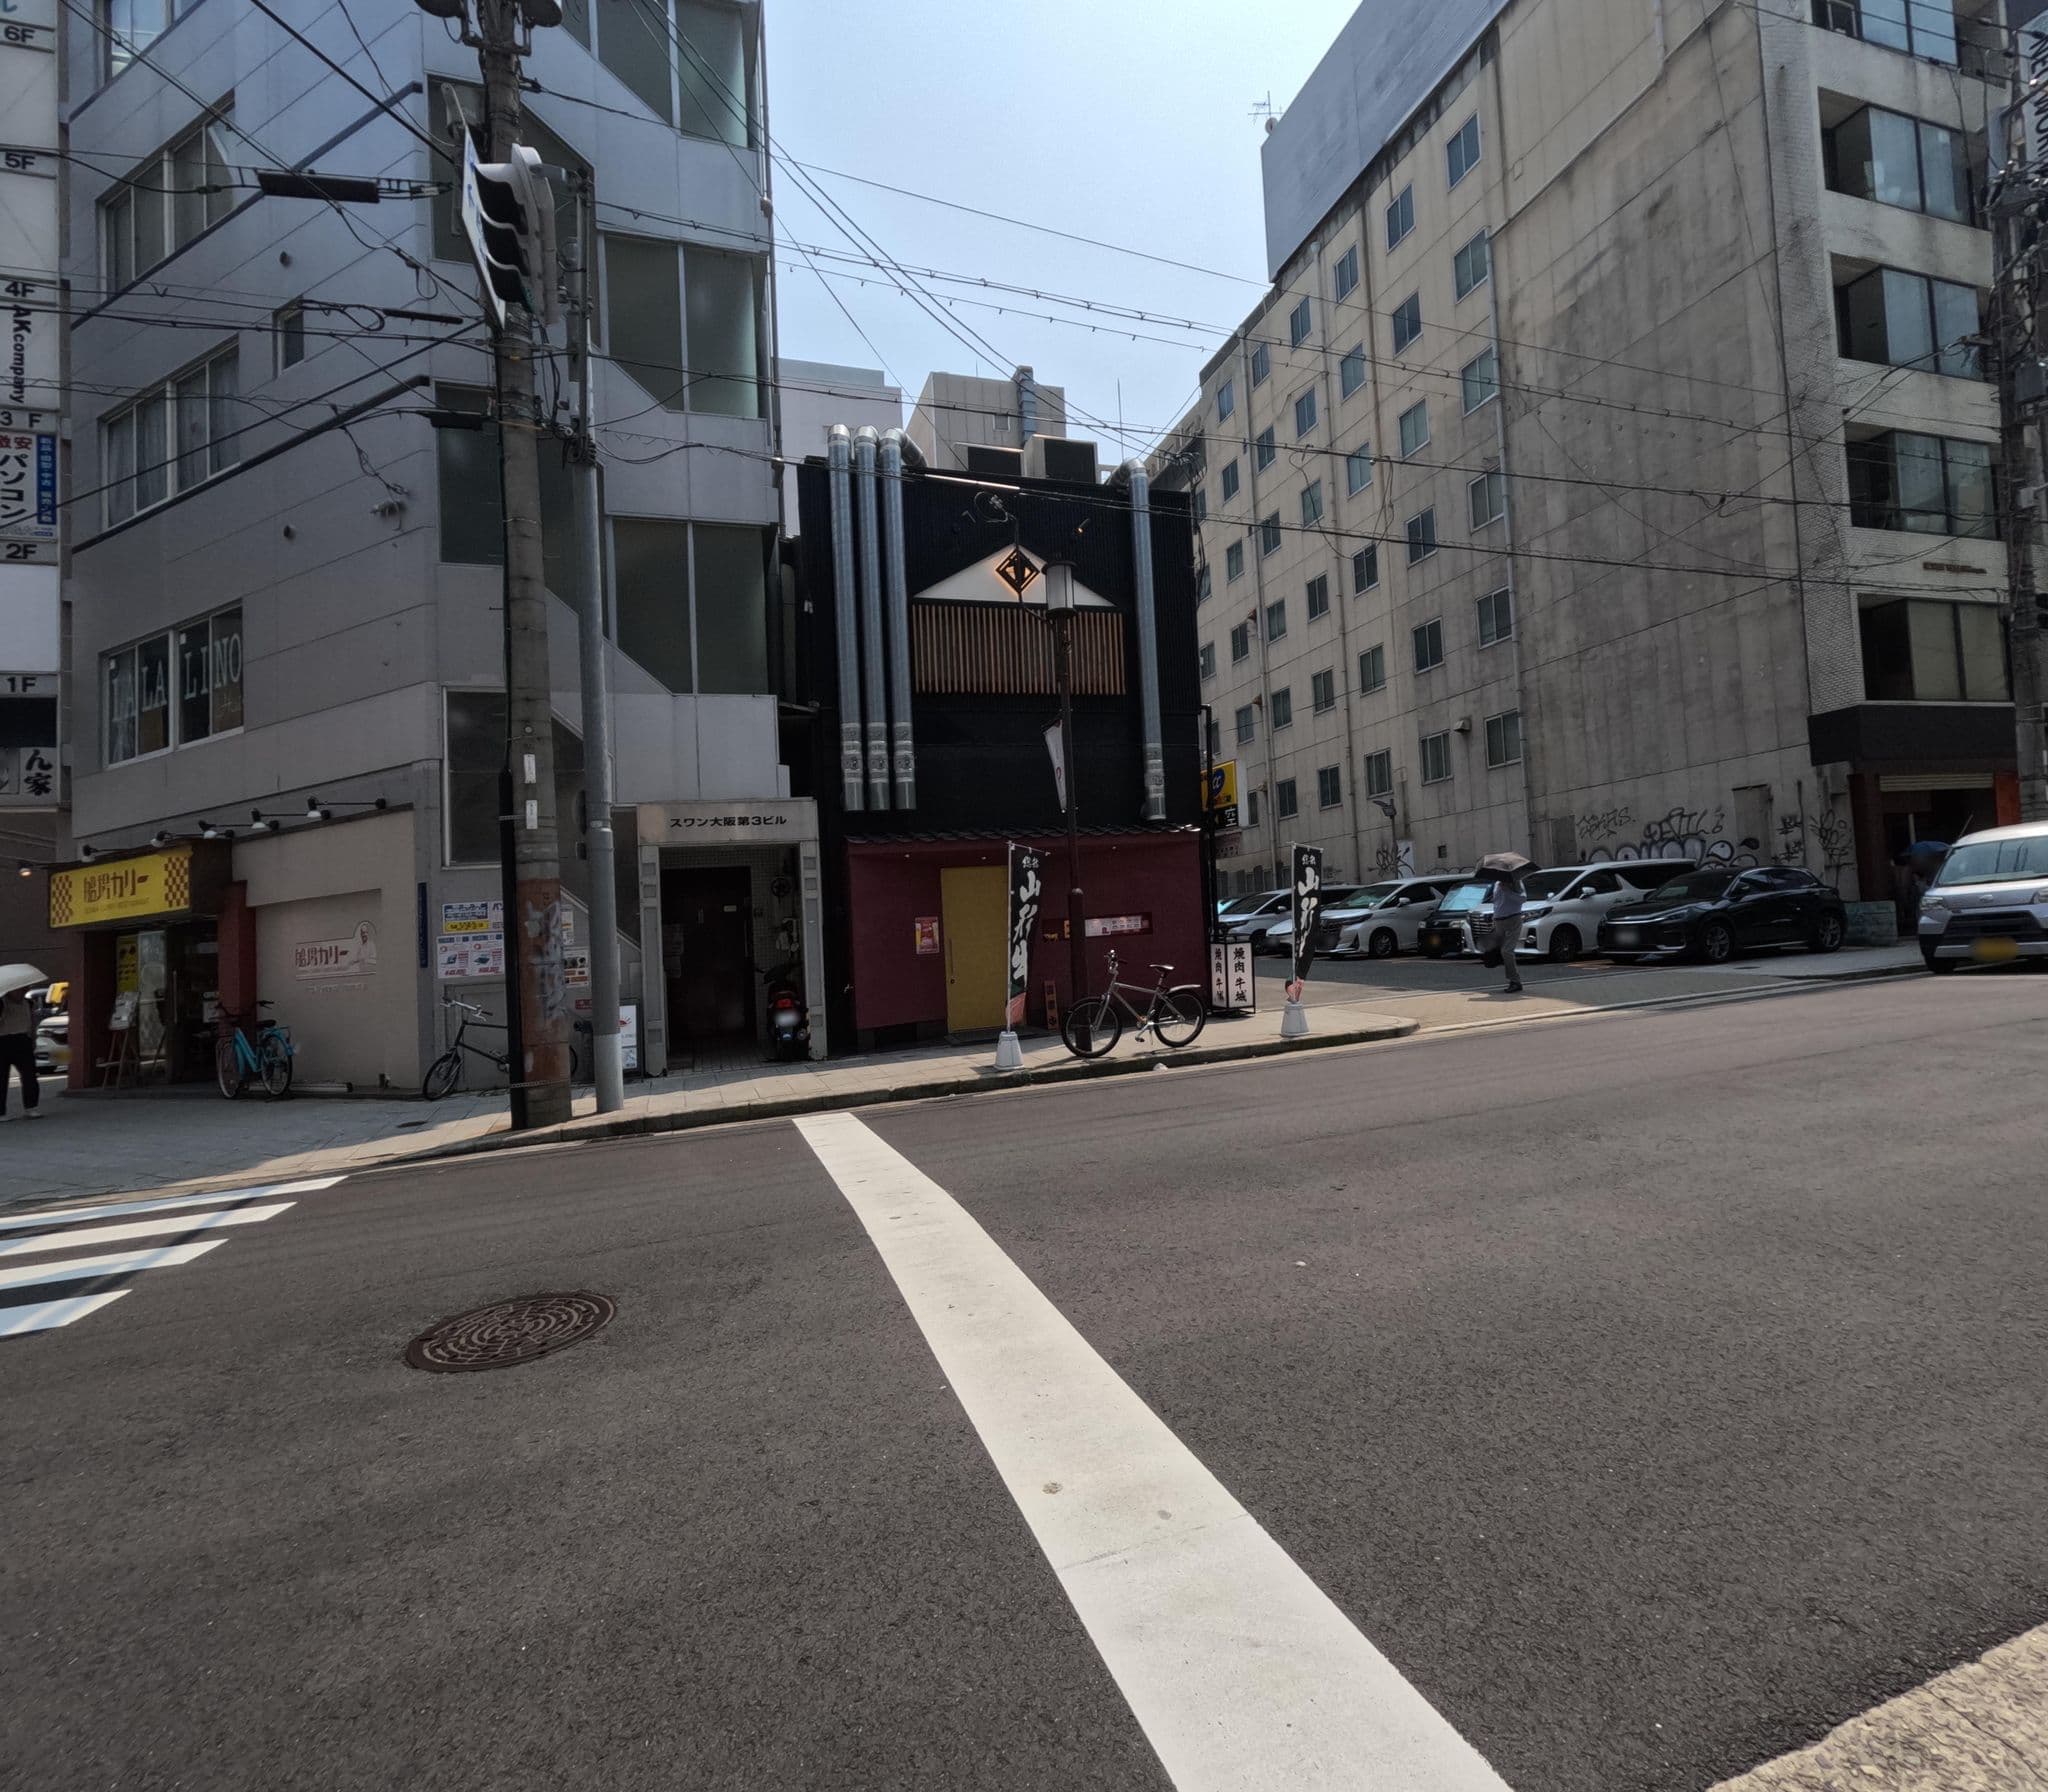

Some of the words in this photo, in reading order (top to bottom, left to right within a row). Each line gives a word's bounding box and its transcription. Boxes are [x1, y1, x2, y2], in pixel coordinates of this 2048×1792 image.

[4, 25, 35, 42] 6F
[4, 151, 36, 170] 5F
[4, 281, 35, 297] 4F
[5, 543, 37, 559] 2F
[6, 677, 37, 692] 1F
